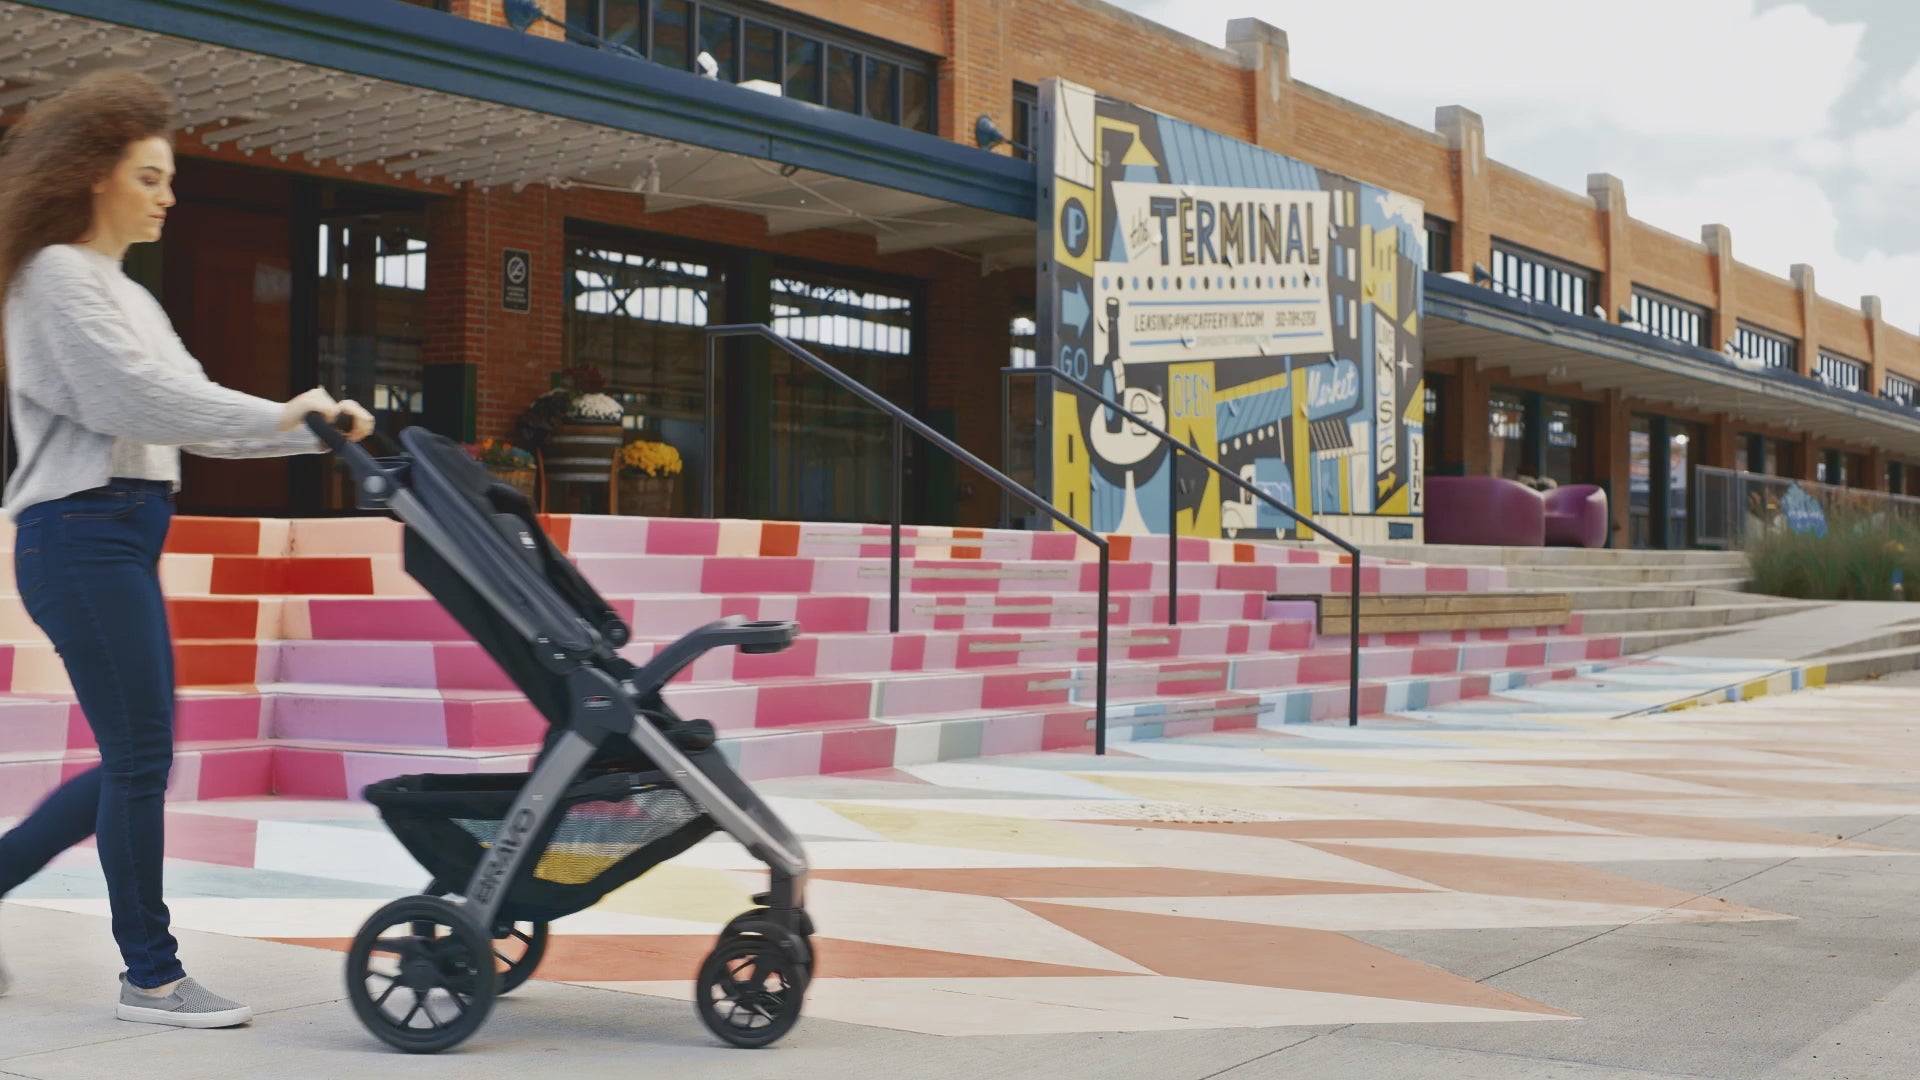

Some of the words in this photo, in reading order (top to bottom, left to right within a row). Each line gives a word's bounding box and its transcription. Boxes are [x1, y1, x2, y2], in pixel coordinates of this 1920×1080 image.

[1067, 206, 1086, 250] P
[1149, 196, 1321, 266] TERMINAL
[1060, 344, 1089, 381] GO
[1173, 372, 1212, 418] OPEN
[1308, 365, 1357, 408] Market
[1412, 437, 1421, 508] YINZ
